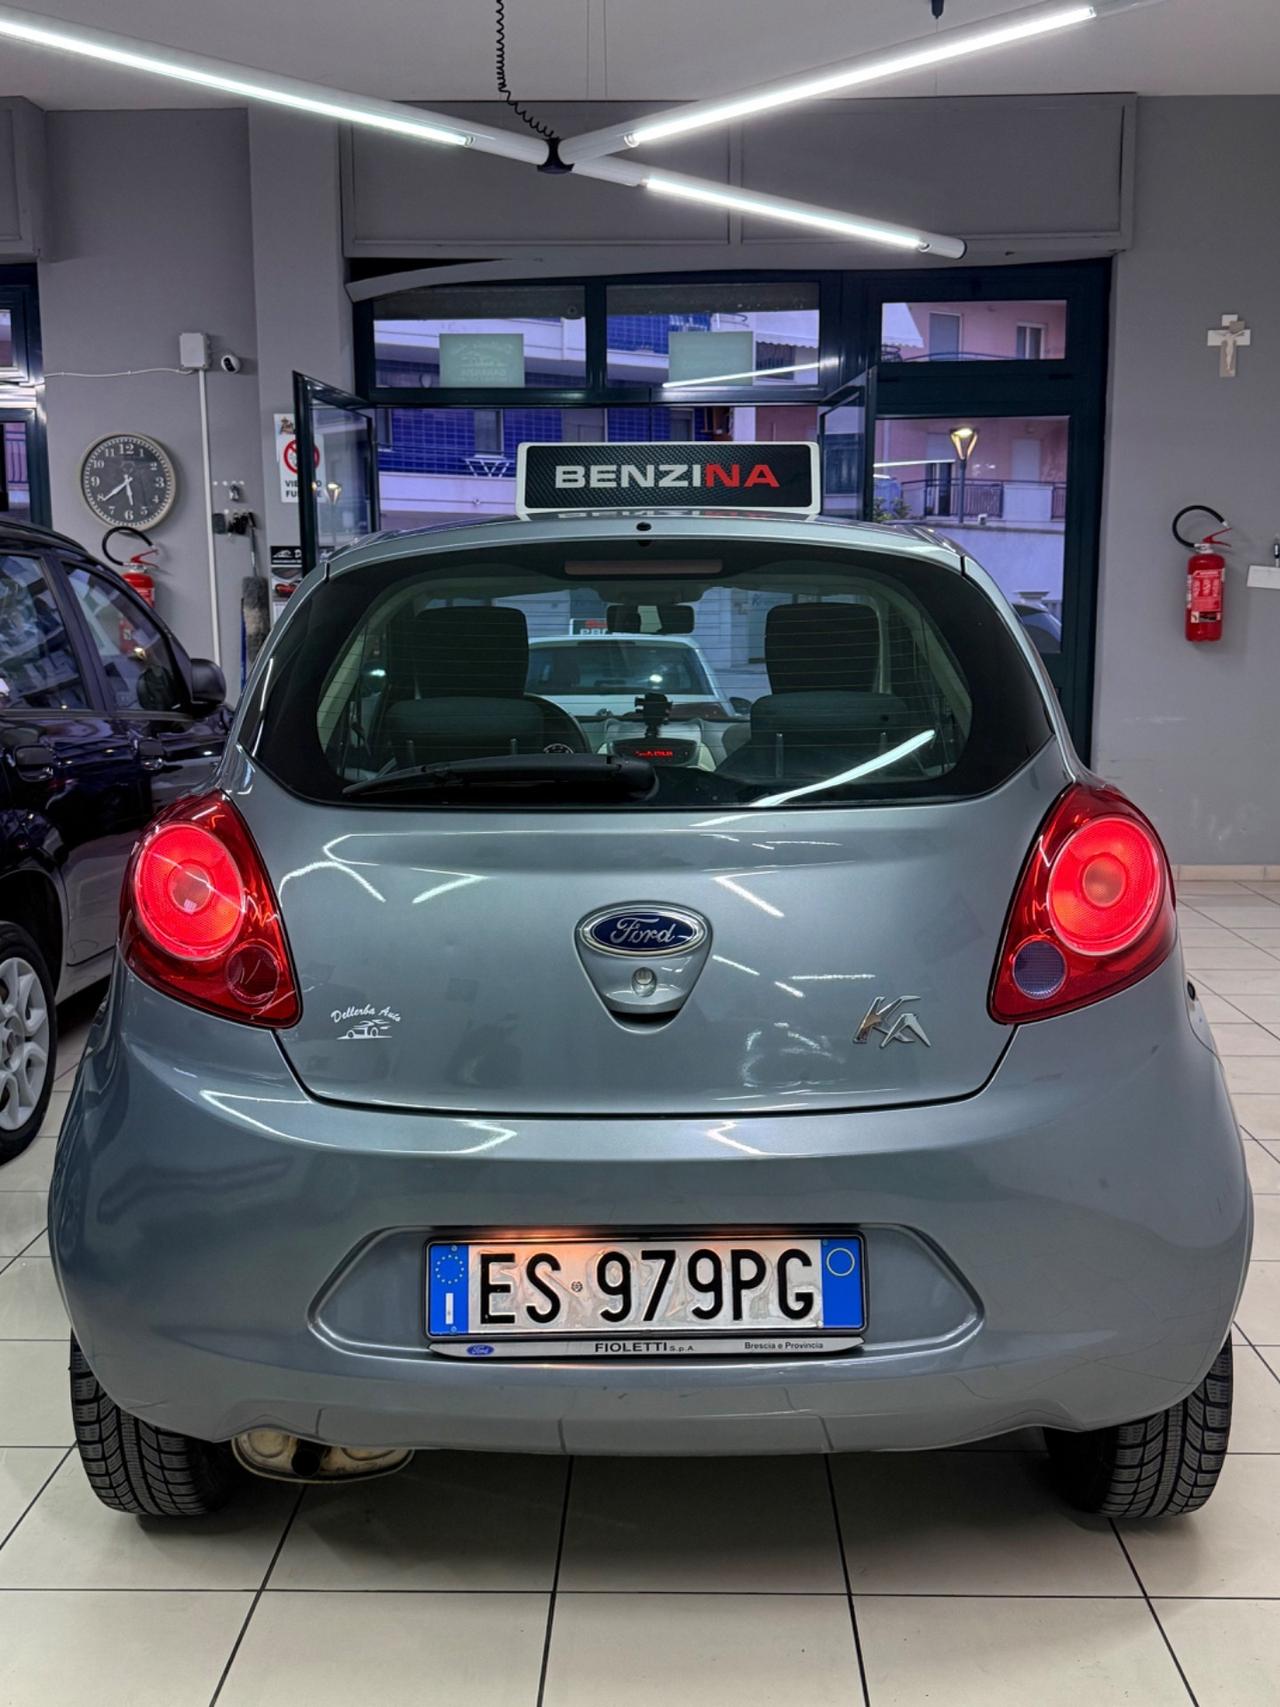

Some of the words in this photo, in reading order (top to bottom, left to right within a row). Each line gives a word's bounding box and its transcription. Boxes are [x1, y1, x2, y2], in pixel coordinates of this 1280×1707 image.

[105, 448, 115, 457] 11
[119, 443, 135, 454] 12
[139, 448, 145, 457] 1
[93, 459, 105, 469] 10
[149, 461, 158, 471] 2
[90, 475, 100, 487] 9
[555, 463, 780, 489] BENZINA
[154, 476, 165, 488] 3
[151, 494, 160, 504] 4
[108, 505, 116, 515] 7
[124, 509, 134, 521] 6
[610, 917, 676, 943] Ford
[330, 1004, 376, 1023] Dellerba
[479, 1253, 562, 1325] ES
[598, 1248, 814, 1322] 979PG
[594, 1342, 668, 1353] FIOLETTI
[744, 1341, 776, 1349] Brescia
[784, 1341, 824, 1349] Provincia
